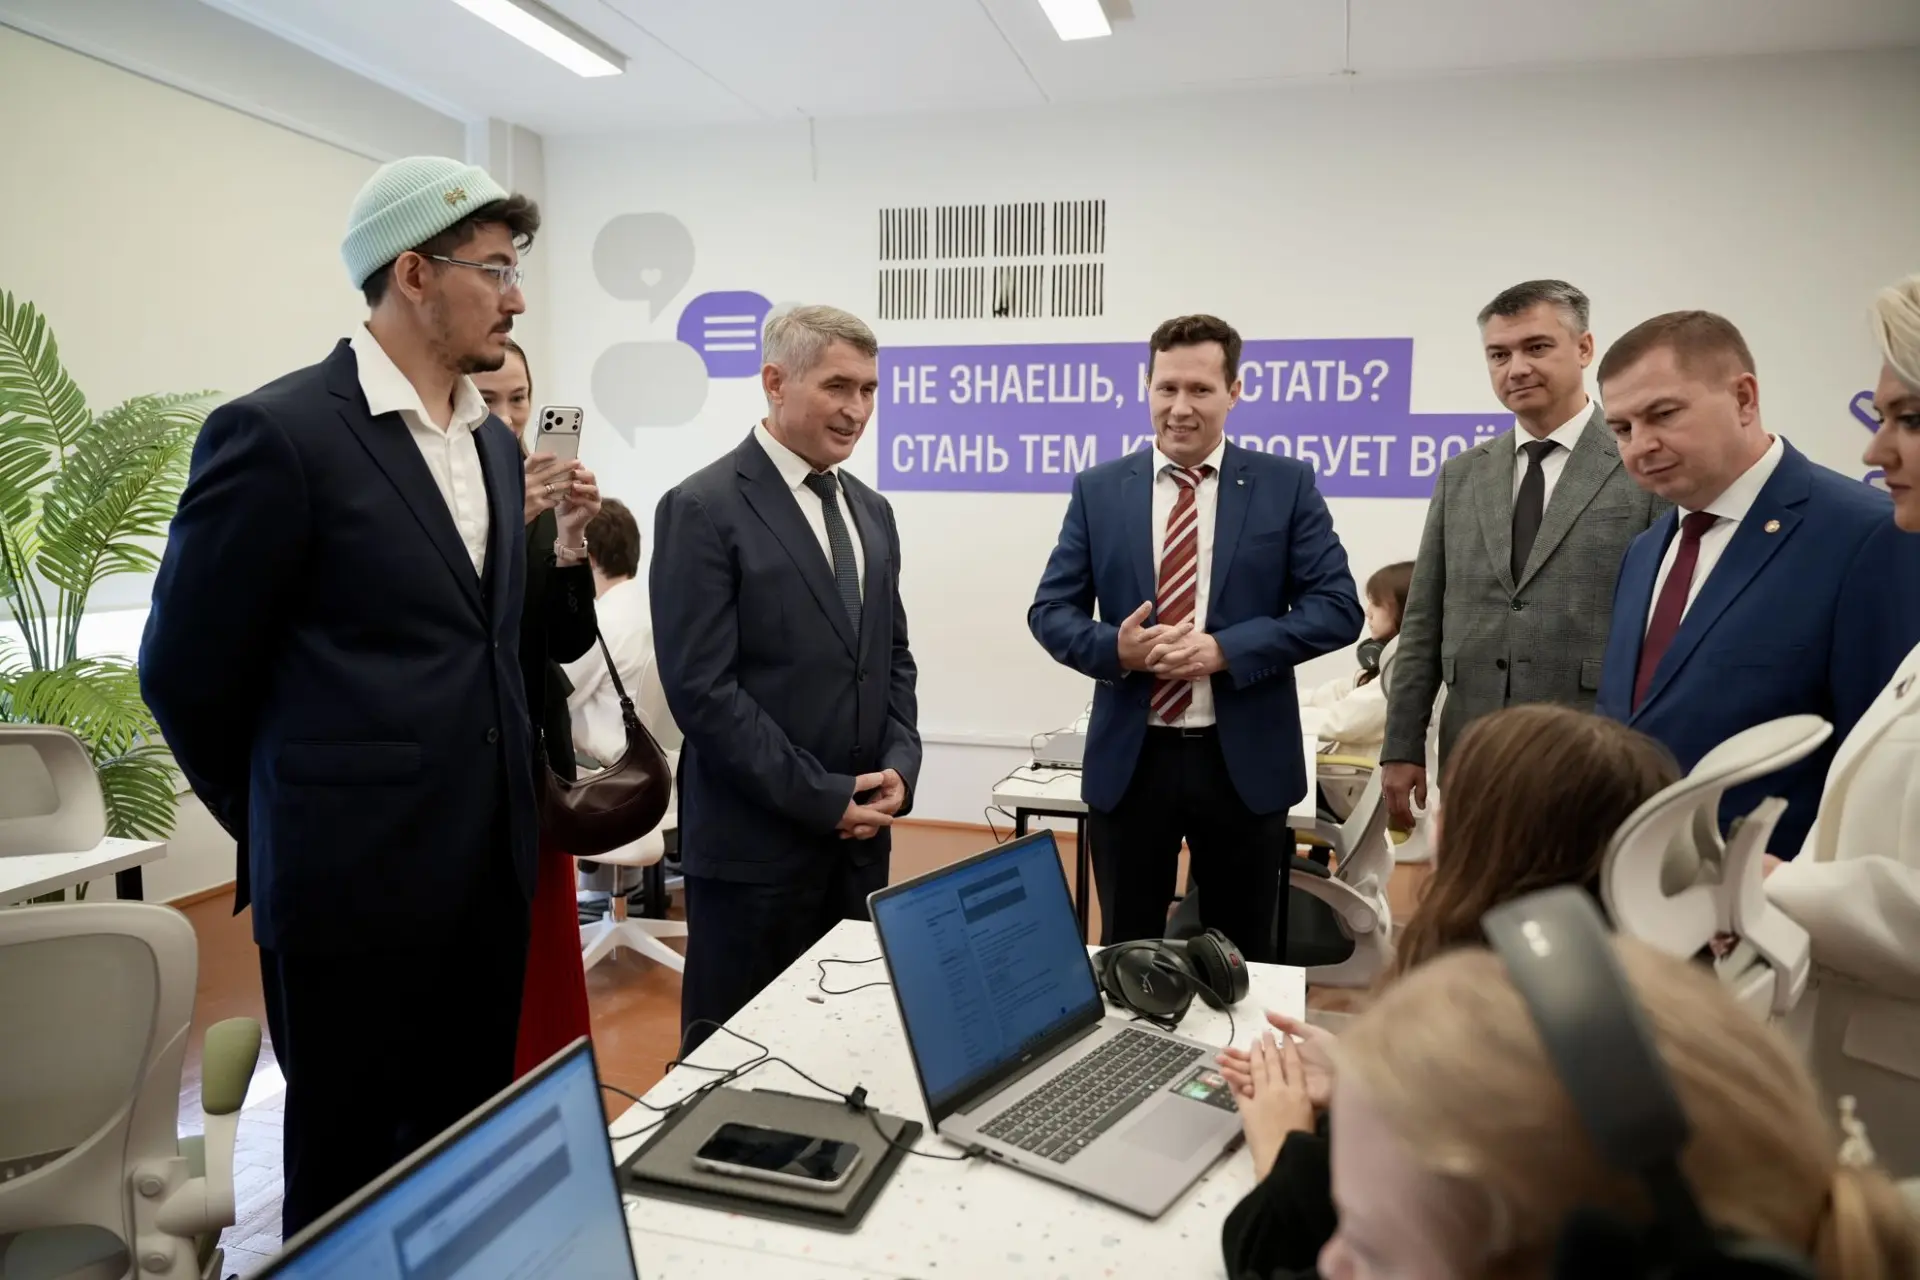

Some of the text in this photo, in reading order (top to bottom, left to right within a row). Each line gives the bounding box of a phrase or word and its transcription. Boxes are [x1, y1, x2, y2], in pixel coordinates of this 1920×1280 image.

[892, 365, 938, 405] НЕ
[949, 362, 1124, 409] ЗНАЕШЬ,
[1237, 359, 1390, 402] СТАТЬ?
[891, 433, 1010, 474] СТАНЬ
[1018, 434, 1097, 474] ТЕМ
